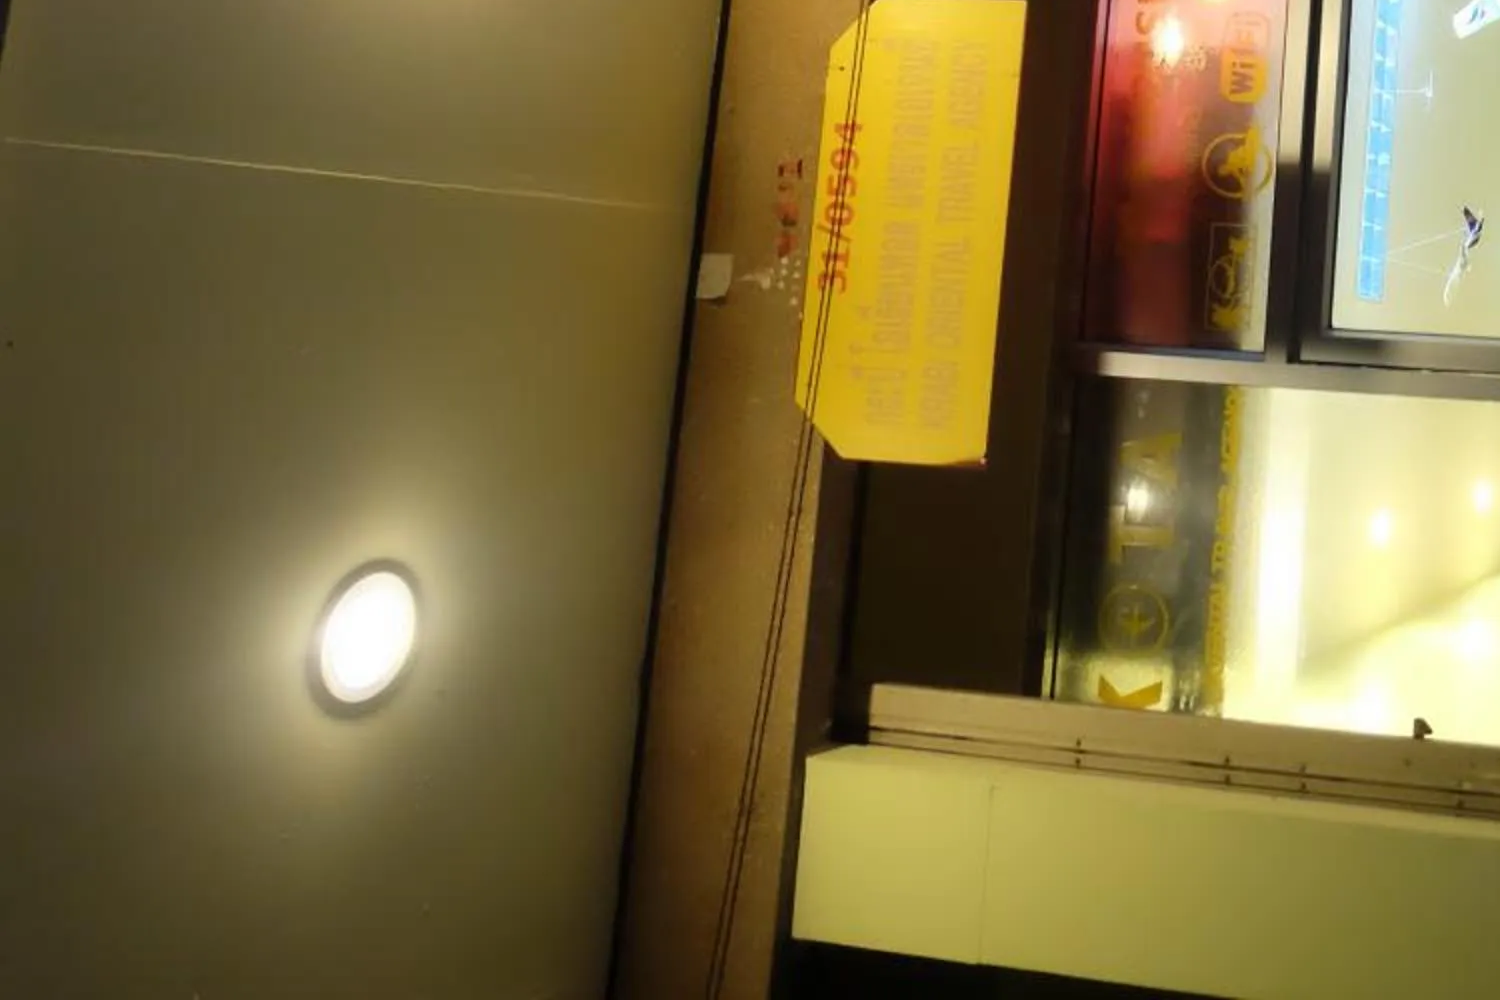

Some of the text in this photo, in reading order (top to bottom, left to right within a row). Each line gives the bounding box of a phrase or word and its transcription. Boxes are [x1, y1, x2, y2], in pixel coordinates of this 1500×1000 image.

[815, 121, 863, 294] 31/0594
[918, 38, 989, 430] KRABI ORIENTAL TRAVEL AGENCY
